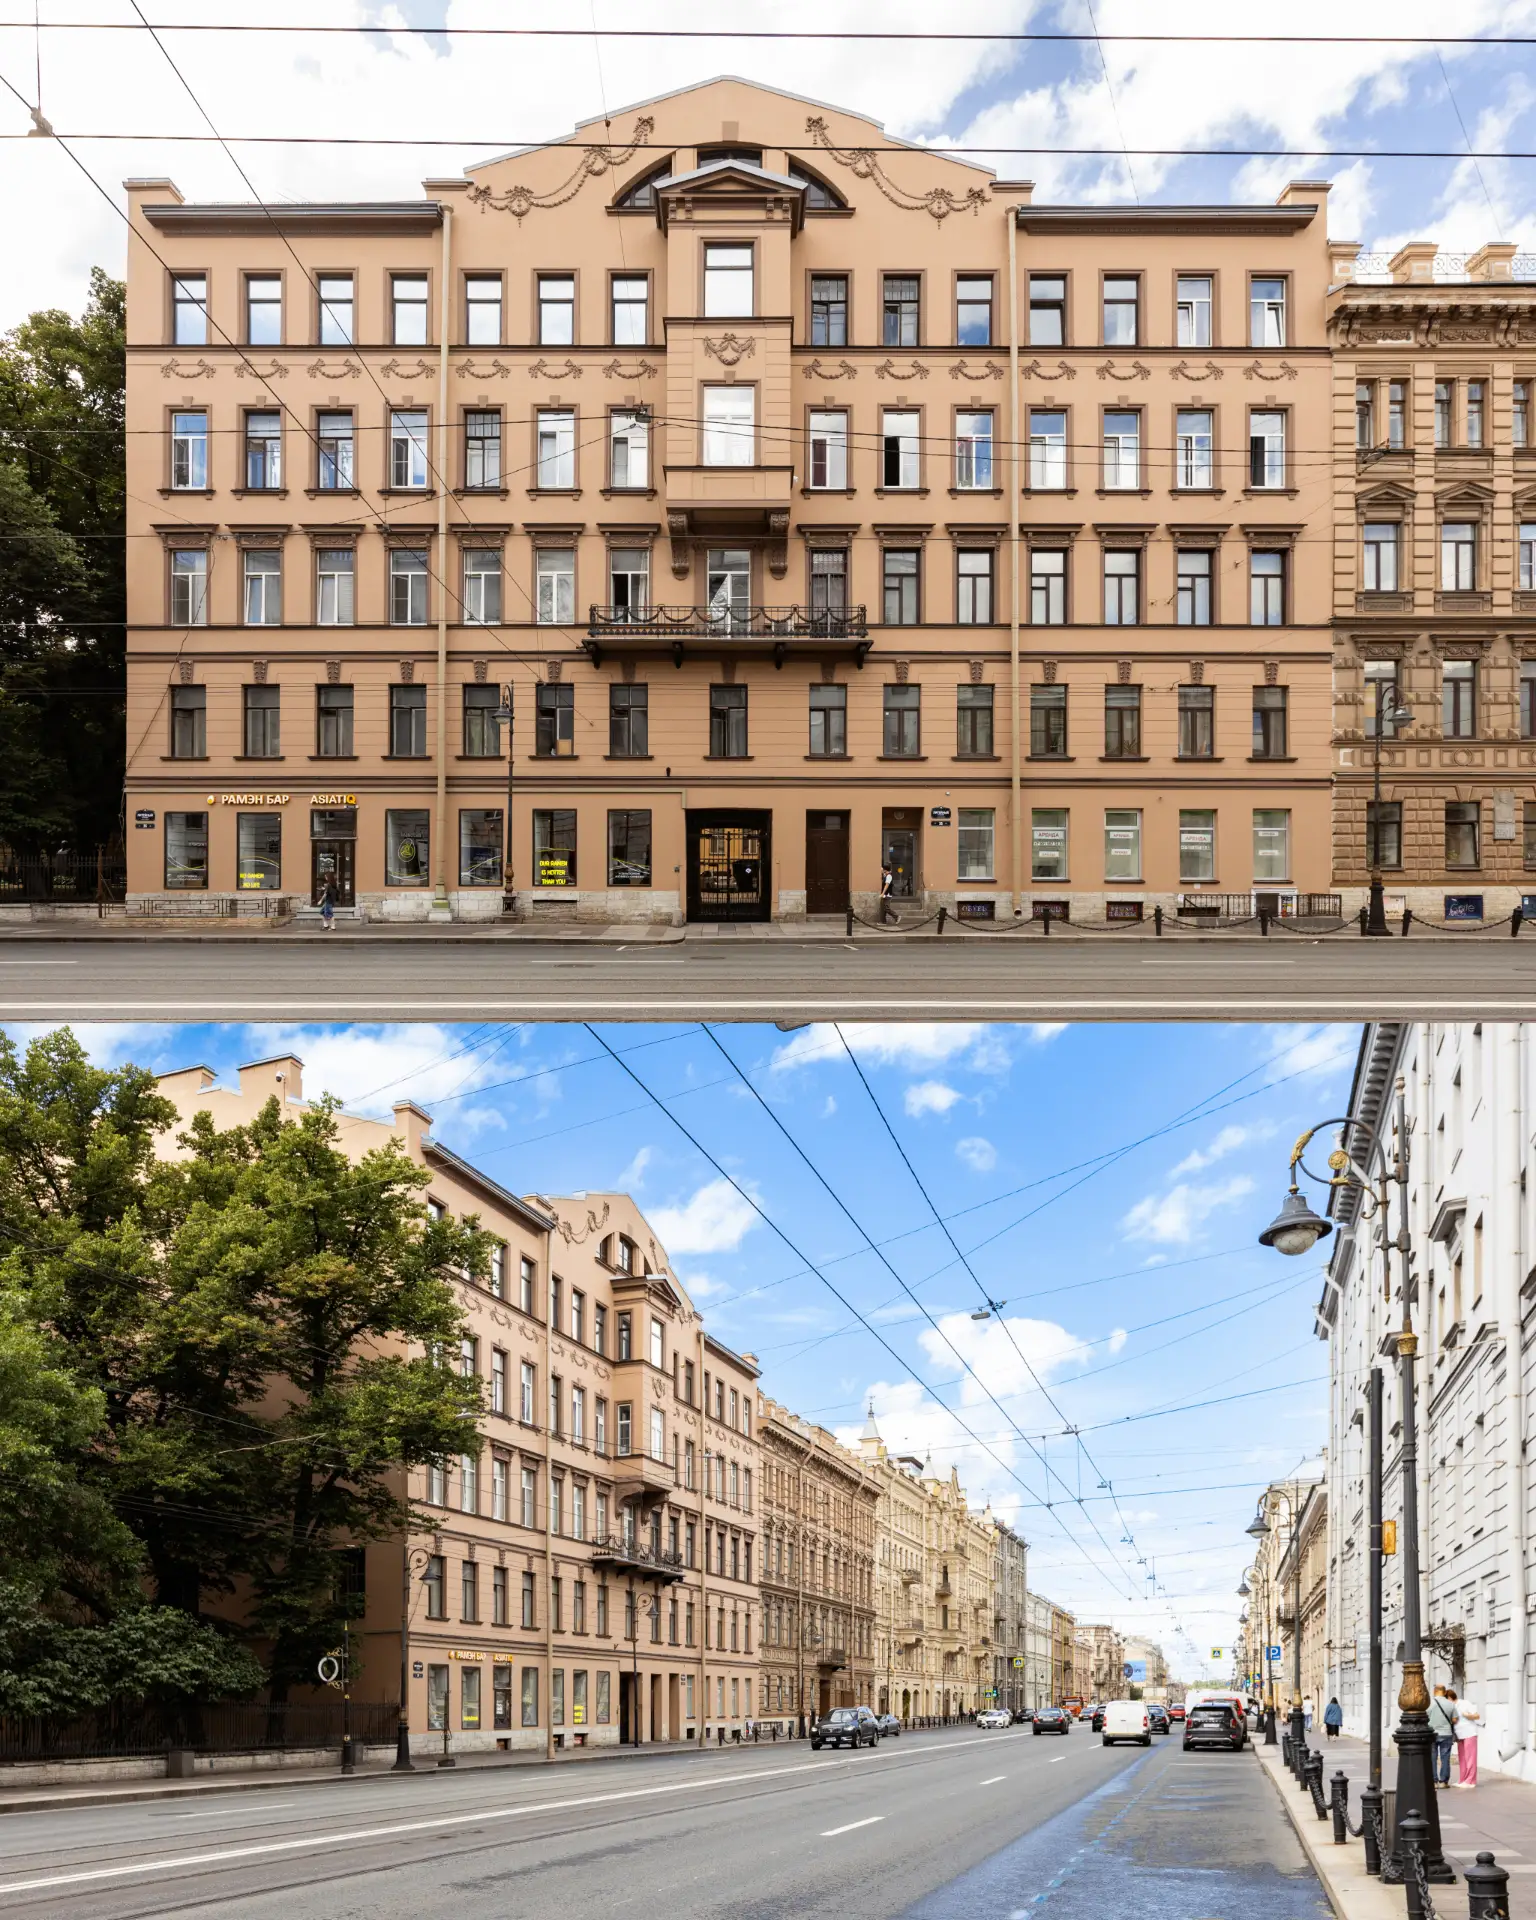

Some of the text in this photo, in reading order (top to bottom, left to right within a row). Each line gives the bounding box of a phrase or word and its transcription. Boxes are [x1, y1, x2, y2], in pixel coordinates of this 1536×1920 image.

[221, 794, 290, 804] РАМЭН БАР
[310, 794, 356, 805] ASIATIQ
